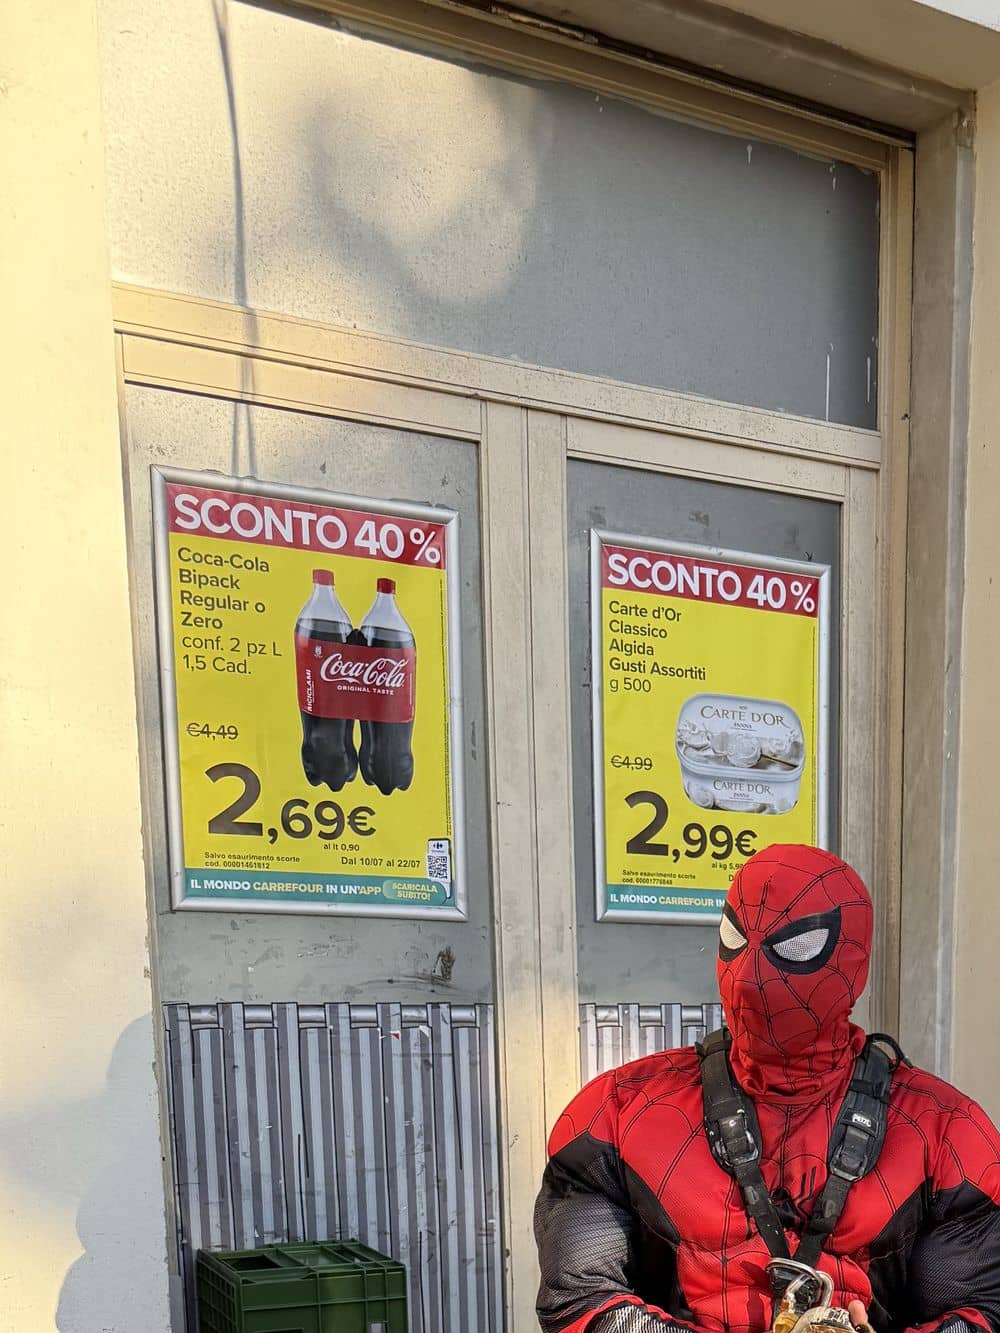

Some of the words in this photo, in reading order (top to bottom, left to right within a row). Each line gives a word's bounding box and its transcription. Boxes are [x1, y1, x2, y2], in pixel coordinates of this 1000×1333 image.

[174, 493, 347, 549] SCONTO
[177, 547, 269, 572] Coca-Cola
[179, 568, 240, 589] Bipack
[608, 553, 742, 601] SCONTO
[180, 590, 249, 611] Regular
[254, 602, 266, 613] o
[609, 600, 648, 618] Carte
[652, 606, 681, 621] d'Or
[180, 611, 223, 629] Zero
[609, 619, 667, 638] Classico
[182, 636, 224, 651] conf.
[229, 637, 240, 652] 2
[247, 643, 267, 657] pz
[272, 642, 282, 656] L
[609, 638, 654, 656] Algida
[183, 654, 206, 672] 1,5
[212, 656, 252, 674] Cad.
[609, 657, 646, 673] Gusti
[650, 662, 705, 680] Assortiti
[337, 685, 371, 693] ORIGINAL
[373, 688, 394, 696] TASTE
[610, 679, 618, 692] g
[624, 677, 651, 692] 500
[700, 705, 746, 721] CARTE
[751, 712, 791, 728] D'OR
[186, 722, 239, 741] €4,49
[611, 755, 652, 771] €4,99
[713, 780, 745, 791] CARTE
[205, 762, 377, 845] 2,69€
[624, 790, 758, 863] 2,99€
[228, 853, 274, 861] esaurimento
[341, 857, 356, 865] Dal
[360, 858, 383, 866] 10/07
[397, 860, 420, 868] 22/07
[190, 879, 201, 889] IL
[203, 880, 251, 890] MONDO
[253, 881, 323, 893] CARREFOUR
[326, 884, 338, 893] IN
[340, 885, 381, 895] UN'APP
[610, 894, 619, 902] IL
[620, 894, 657, 904] MONDO
[659, 896, 714, 906] CARREFOUR
